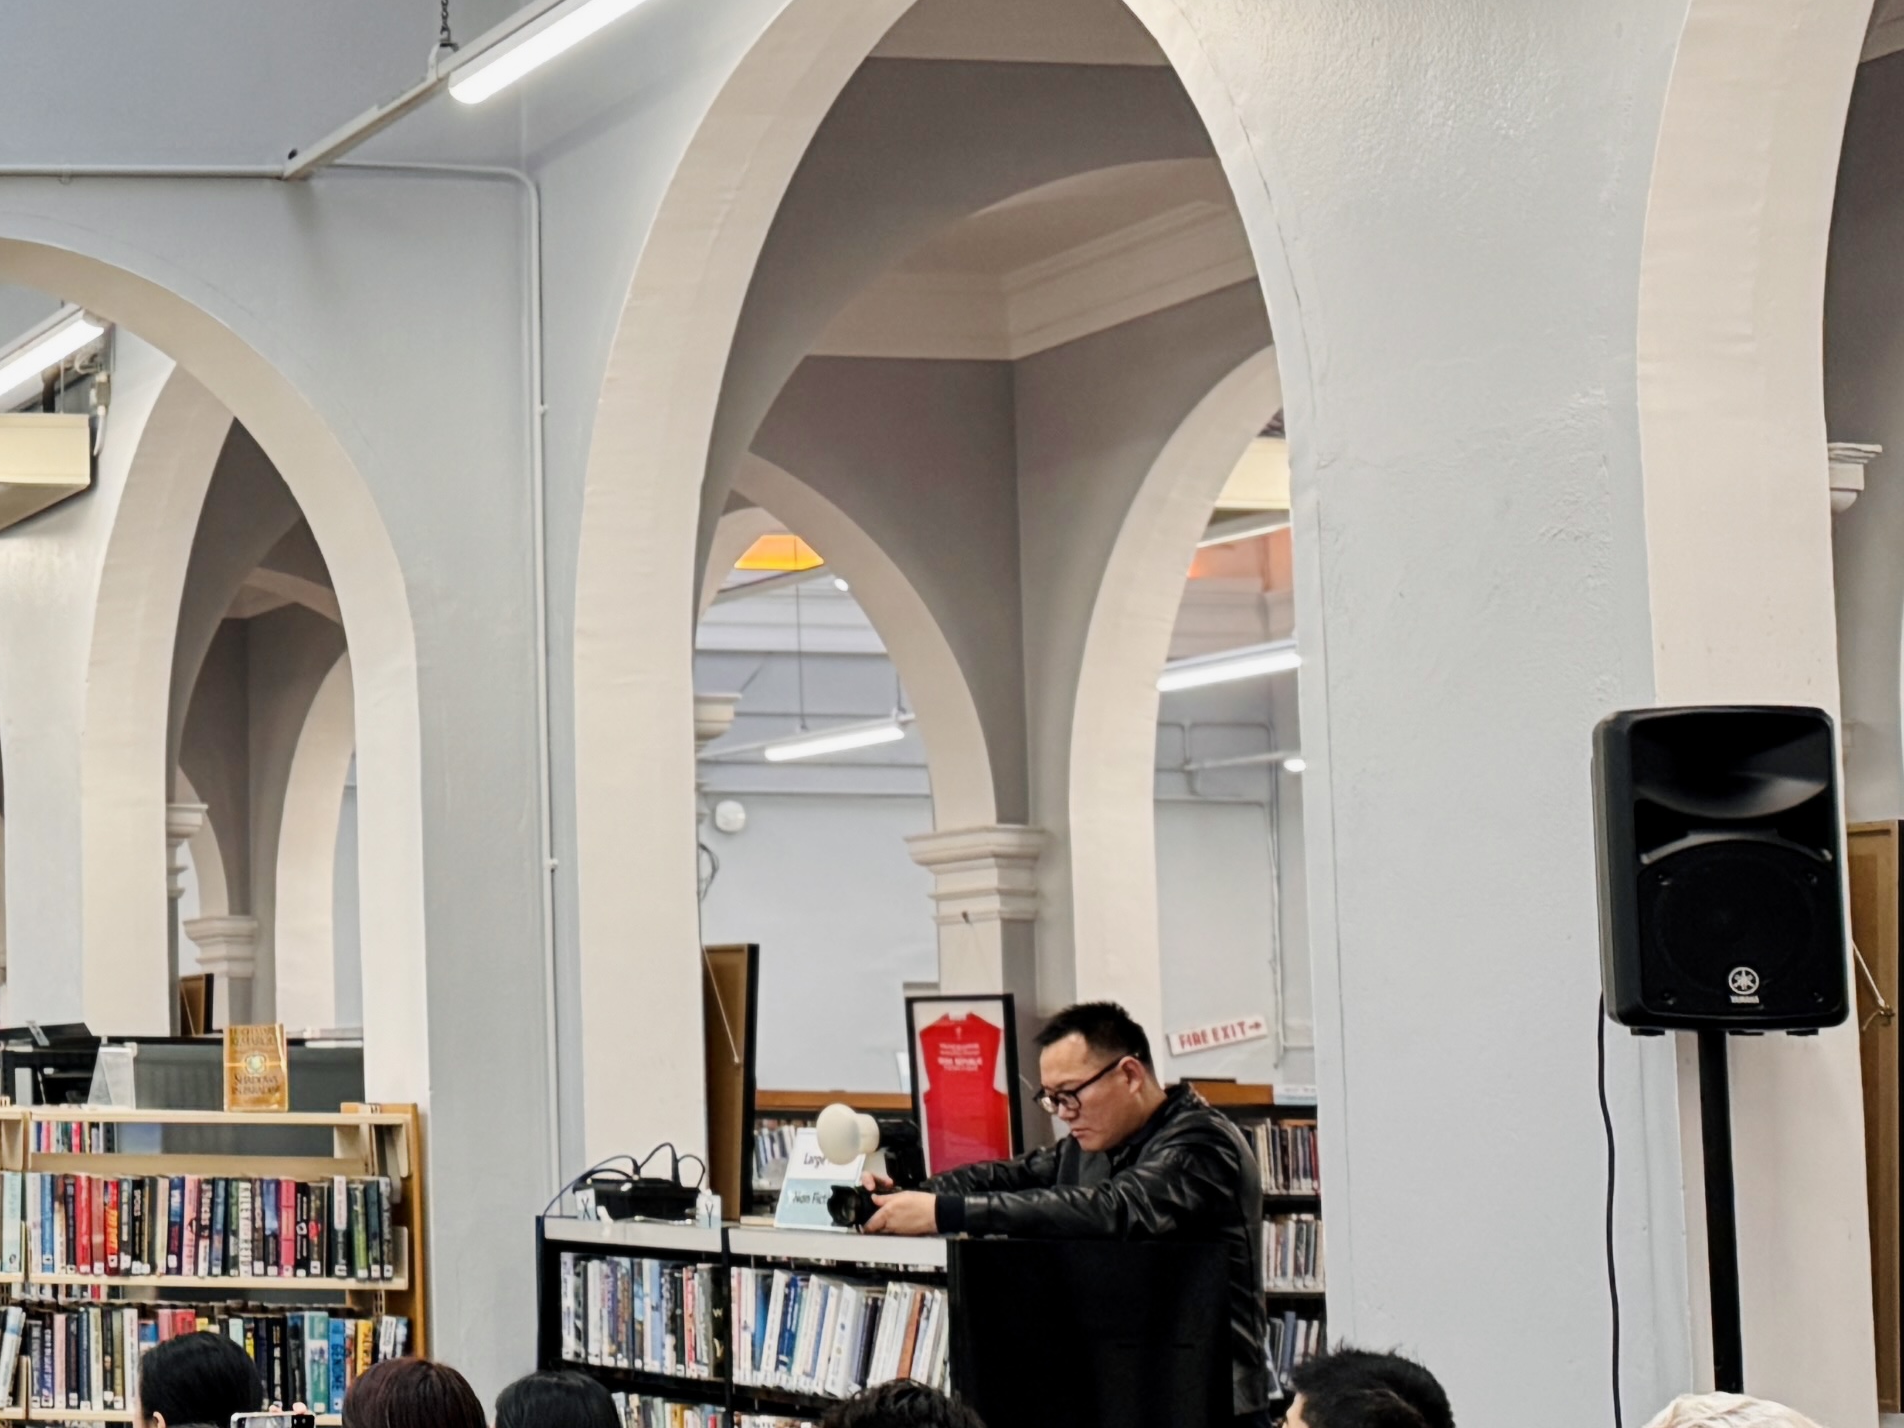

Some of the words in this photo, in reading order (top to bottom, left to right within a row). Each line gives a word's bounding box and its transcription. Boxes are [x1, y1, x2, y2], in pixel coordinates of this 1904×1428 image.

[1178, 1029, 1209, 1050] FIRE
[1211, 1020, 1246, 1043] EXIT
[803, 1151, 826, 1168] Large
[580, 1197, 590, 1220] X
[793, 1190, 810, 1204] Non
[705, 1203, 714, 1230] Y
